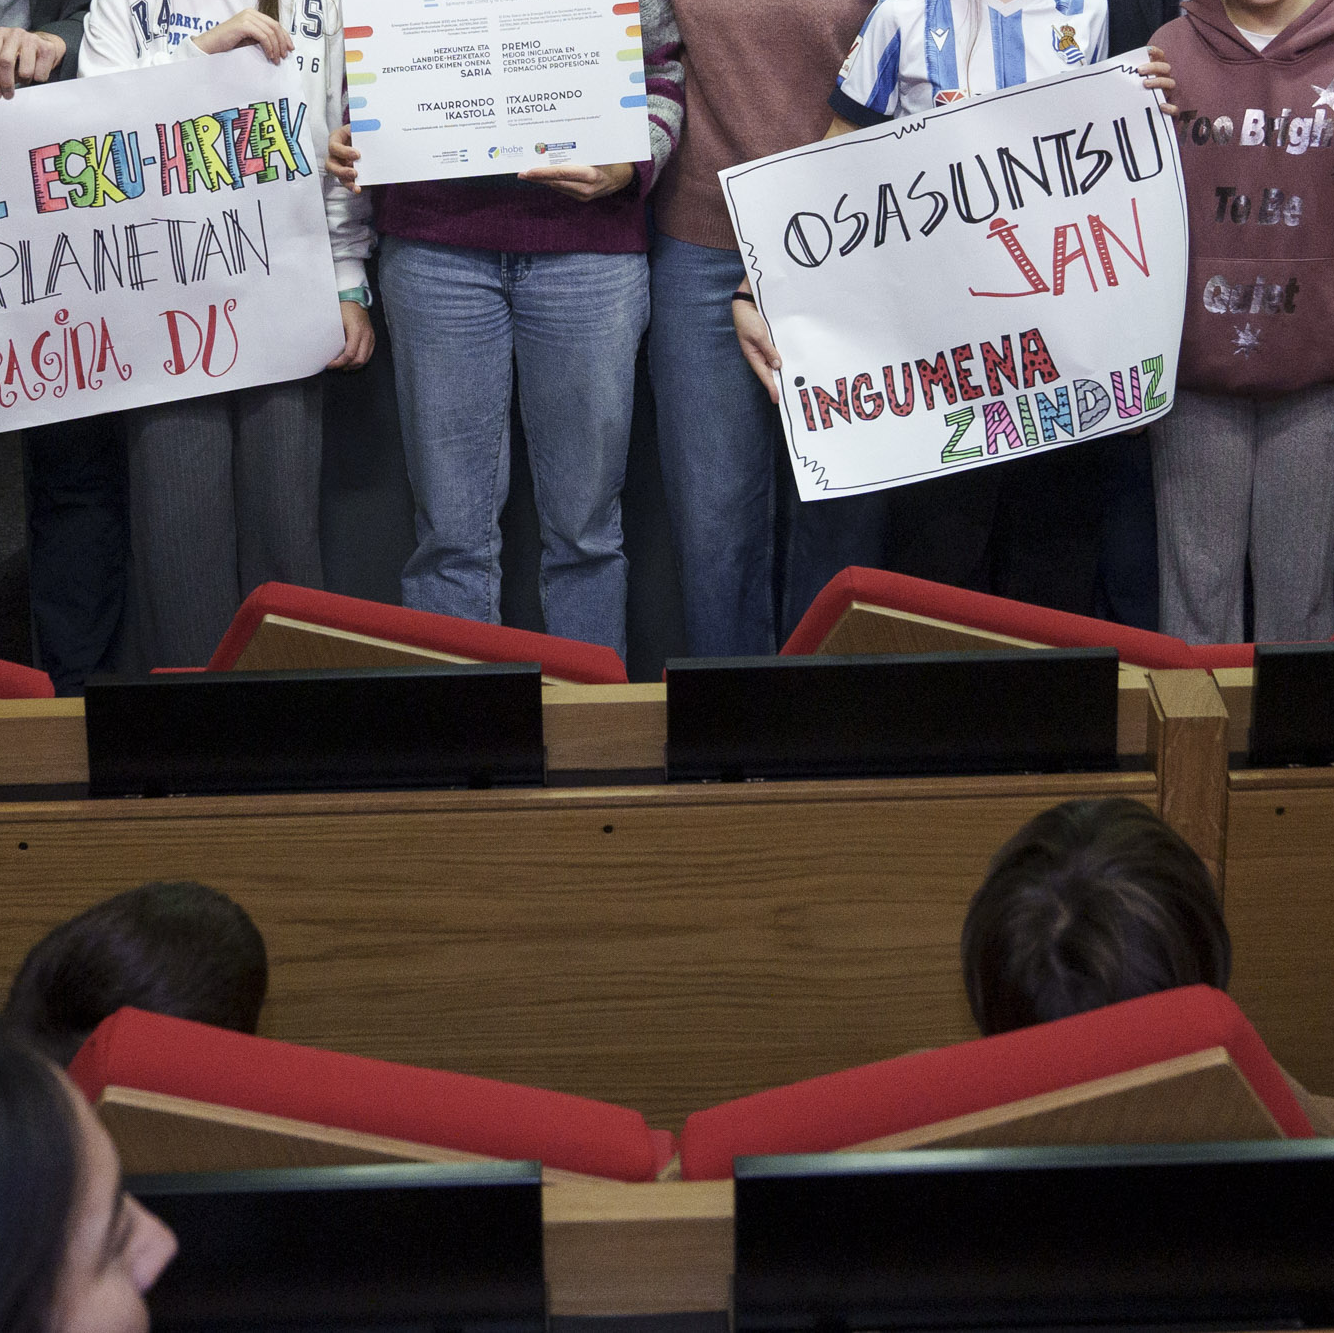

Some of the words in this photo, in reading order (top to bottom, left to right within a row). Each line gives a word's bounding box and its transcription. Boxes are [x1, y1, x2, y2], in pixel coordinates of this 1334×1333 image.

[433, 45, 475, 55] HEZKUNTZA
[501, 40, 541, 51] PREMIO
[502, 50, 525, 59] MEJOR
[527, 47, 563, 57] INICIATIVA
[565, 46, 575, 54] EN
[412, 51, 491, 64] LANBIDE-HEZIKETAKO
[503, 57, 536, 66] CENTROS
[538, 52, 582, 64] EDUCATIVOS
[382, 64, 434, 74] ZENTROETAKO
[435, 62, 463, 71] EKIMEN
[464, 59, 491, 68] ONENA
[460, 68, 492, 78] SARIA
[503, 62, 548, 74] FORMACIÓN
[549, 58, 600, 70] PROFESIONAL
[506, 89, 583, 104] ITXAURRONDO
[417, 97, 495, 112] ITXAURRONDO
[507, 103, 557, 115] IKASTOLA
[445, 108, 496, 121] IKASTOLA
[1179, 109, 1234, 147] Too
[28, 97, 313, 214] ESKU-HARTZEAK
[500, 145, 524, 154] ihobe
[784, 107, 1164, 268] OSASUNTSU
[1215, 186, 1252, 225] To
[1258, 187, 1304, 227] Be
[968, 198, 1150, 298] JAN
[1202, 274, 1300, 315] Quiet
[158, 298, 240, 379] DU
[941, 354, 1168, 464] ZAINDUZ
